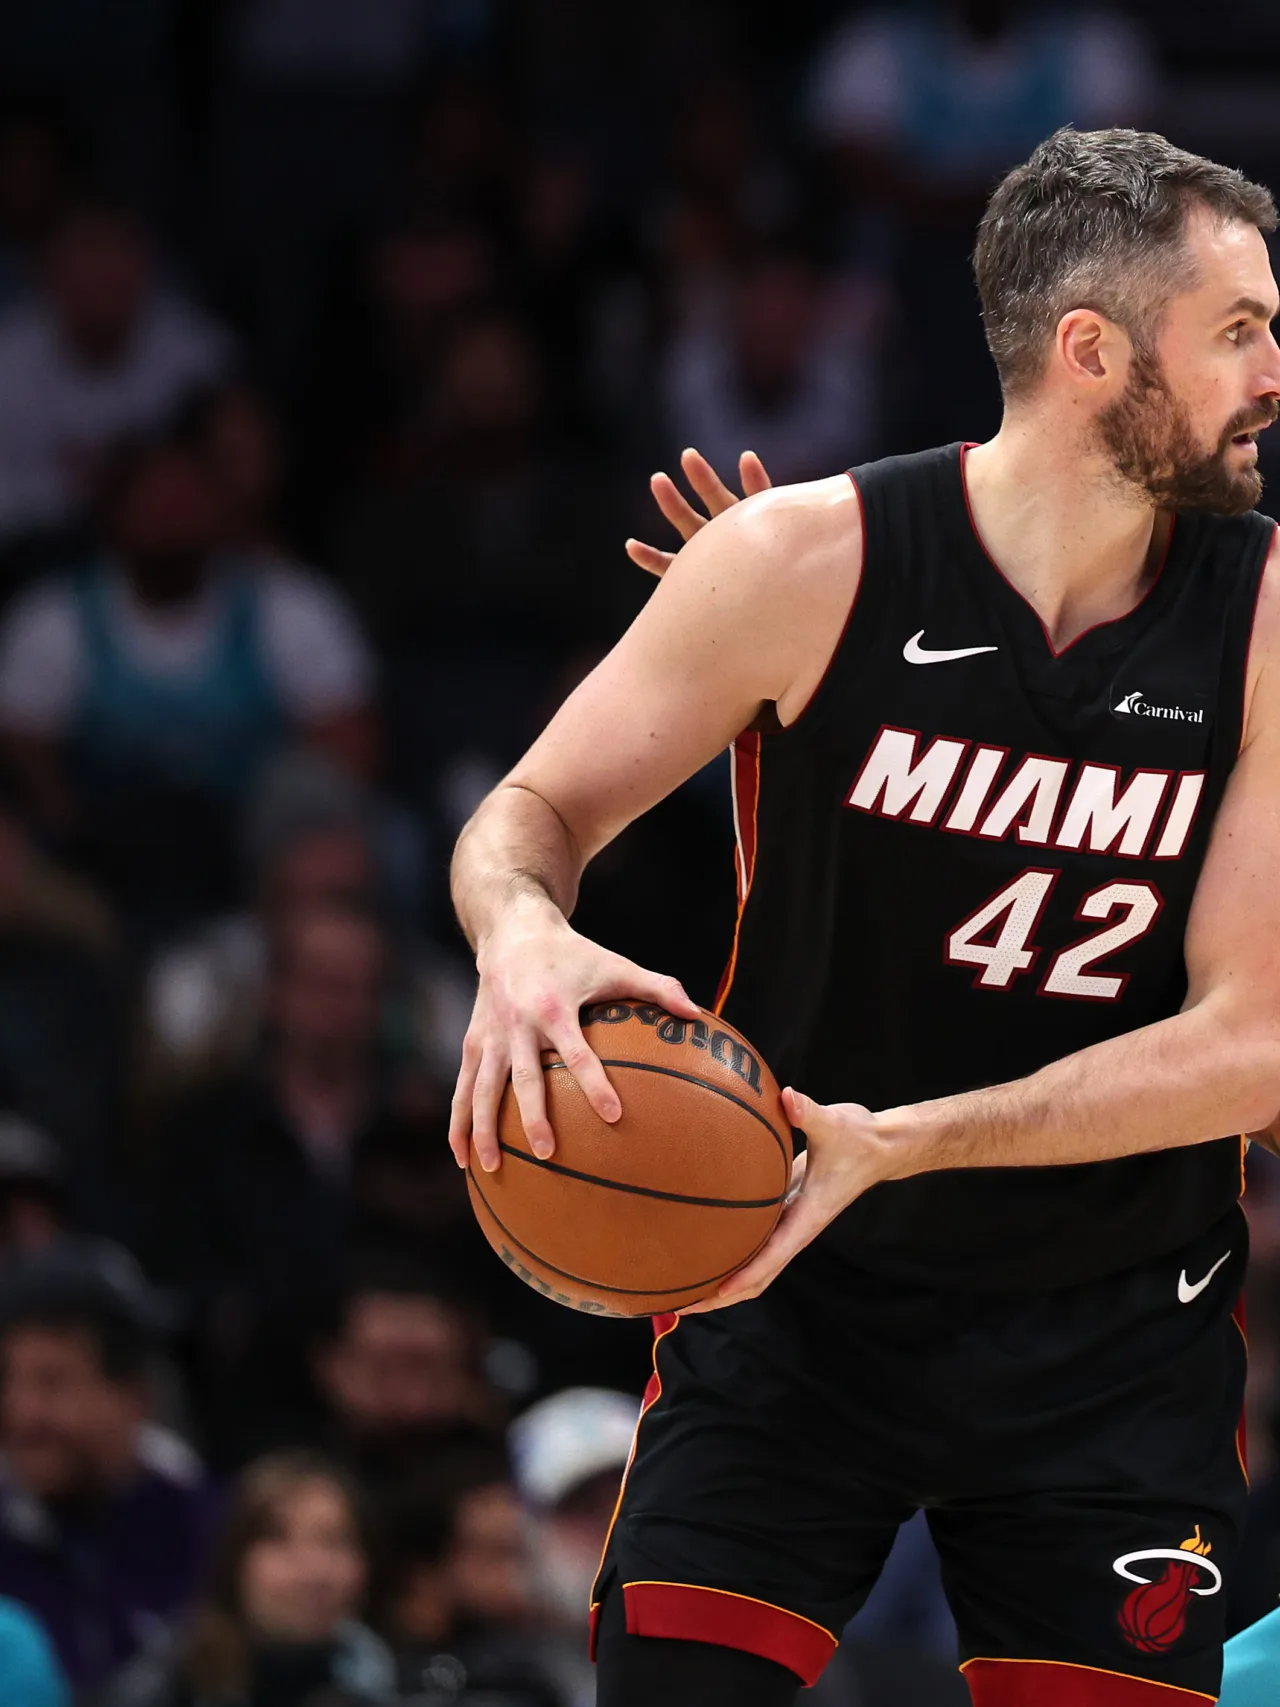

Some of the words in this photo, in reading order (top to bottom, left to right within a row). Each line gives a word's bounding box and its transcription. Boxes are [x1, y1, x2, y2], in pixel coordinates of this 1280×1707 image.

[1133, 702, 1204, 723] Carnival
[843, 724, 1207, 860] MIAMI
[943, 866, 1165, 1000] 42
[578, 1003, 762, 1096] Wilso
